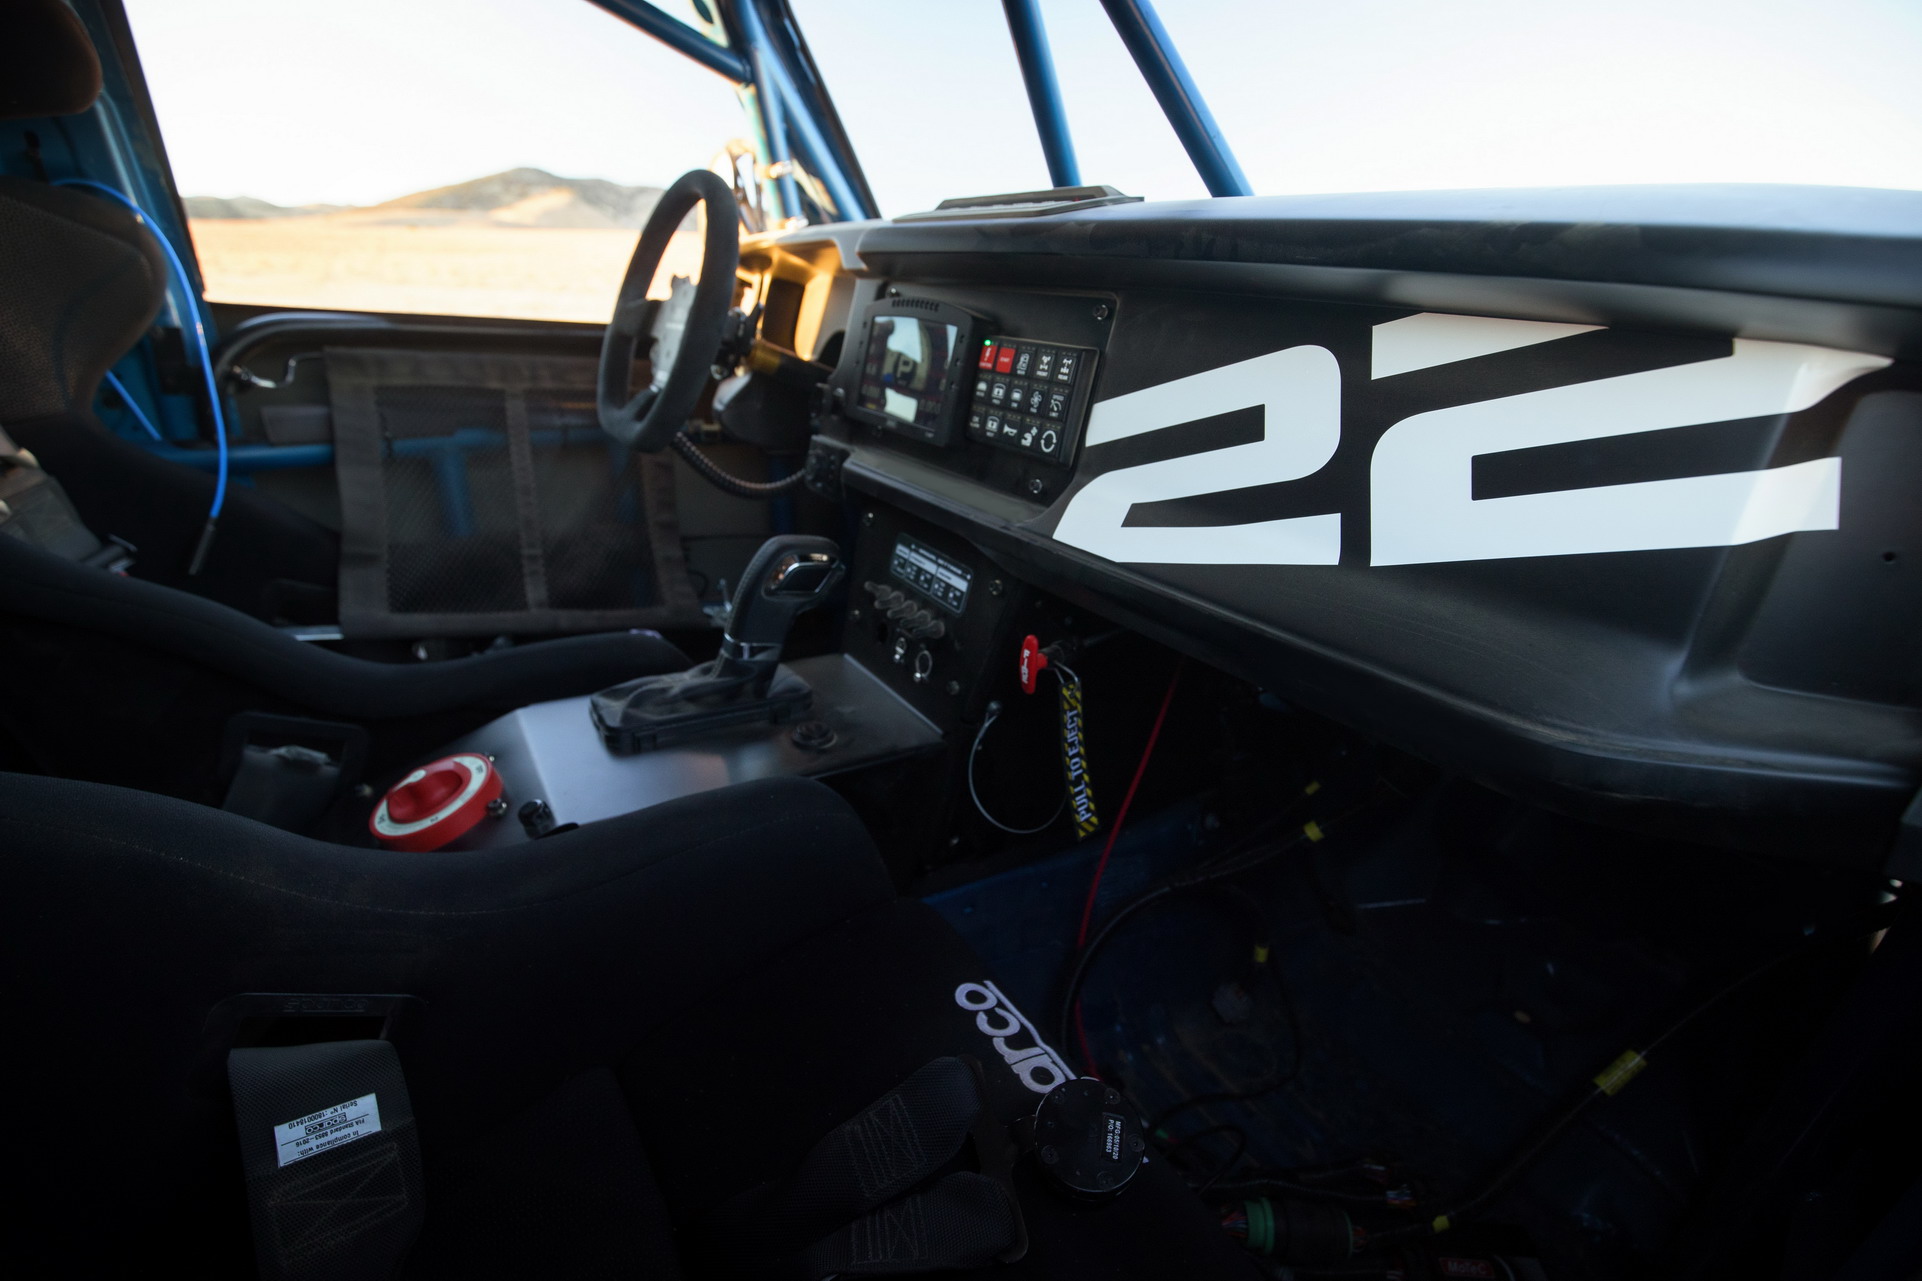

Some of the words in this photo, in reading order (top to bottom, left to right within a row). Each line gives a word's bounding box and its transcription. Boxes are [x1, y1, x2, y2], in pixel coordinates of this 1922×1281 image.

[1052, 311, 1895, 567] 22
[1066, 710, 1080, 757] EJECT
[1069, 757, 1083, 781] TO
[1074, 781, 1092, 822] PULL
[340, 1100, 358, 1111] Serial
[330, 1124, 354, 1135] Standard
[355, 1118, 365, 1126] FIA
[316, 1132, 351, 1150] compliance
[297, 1146, 315, 1157] with:
